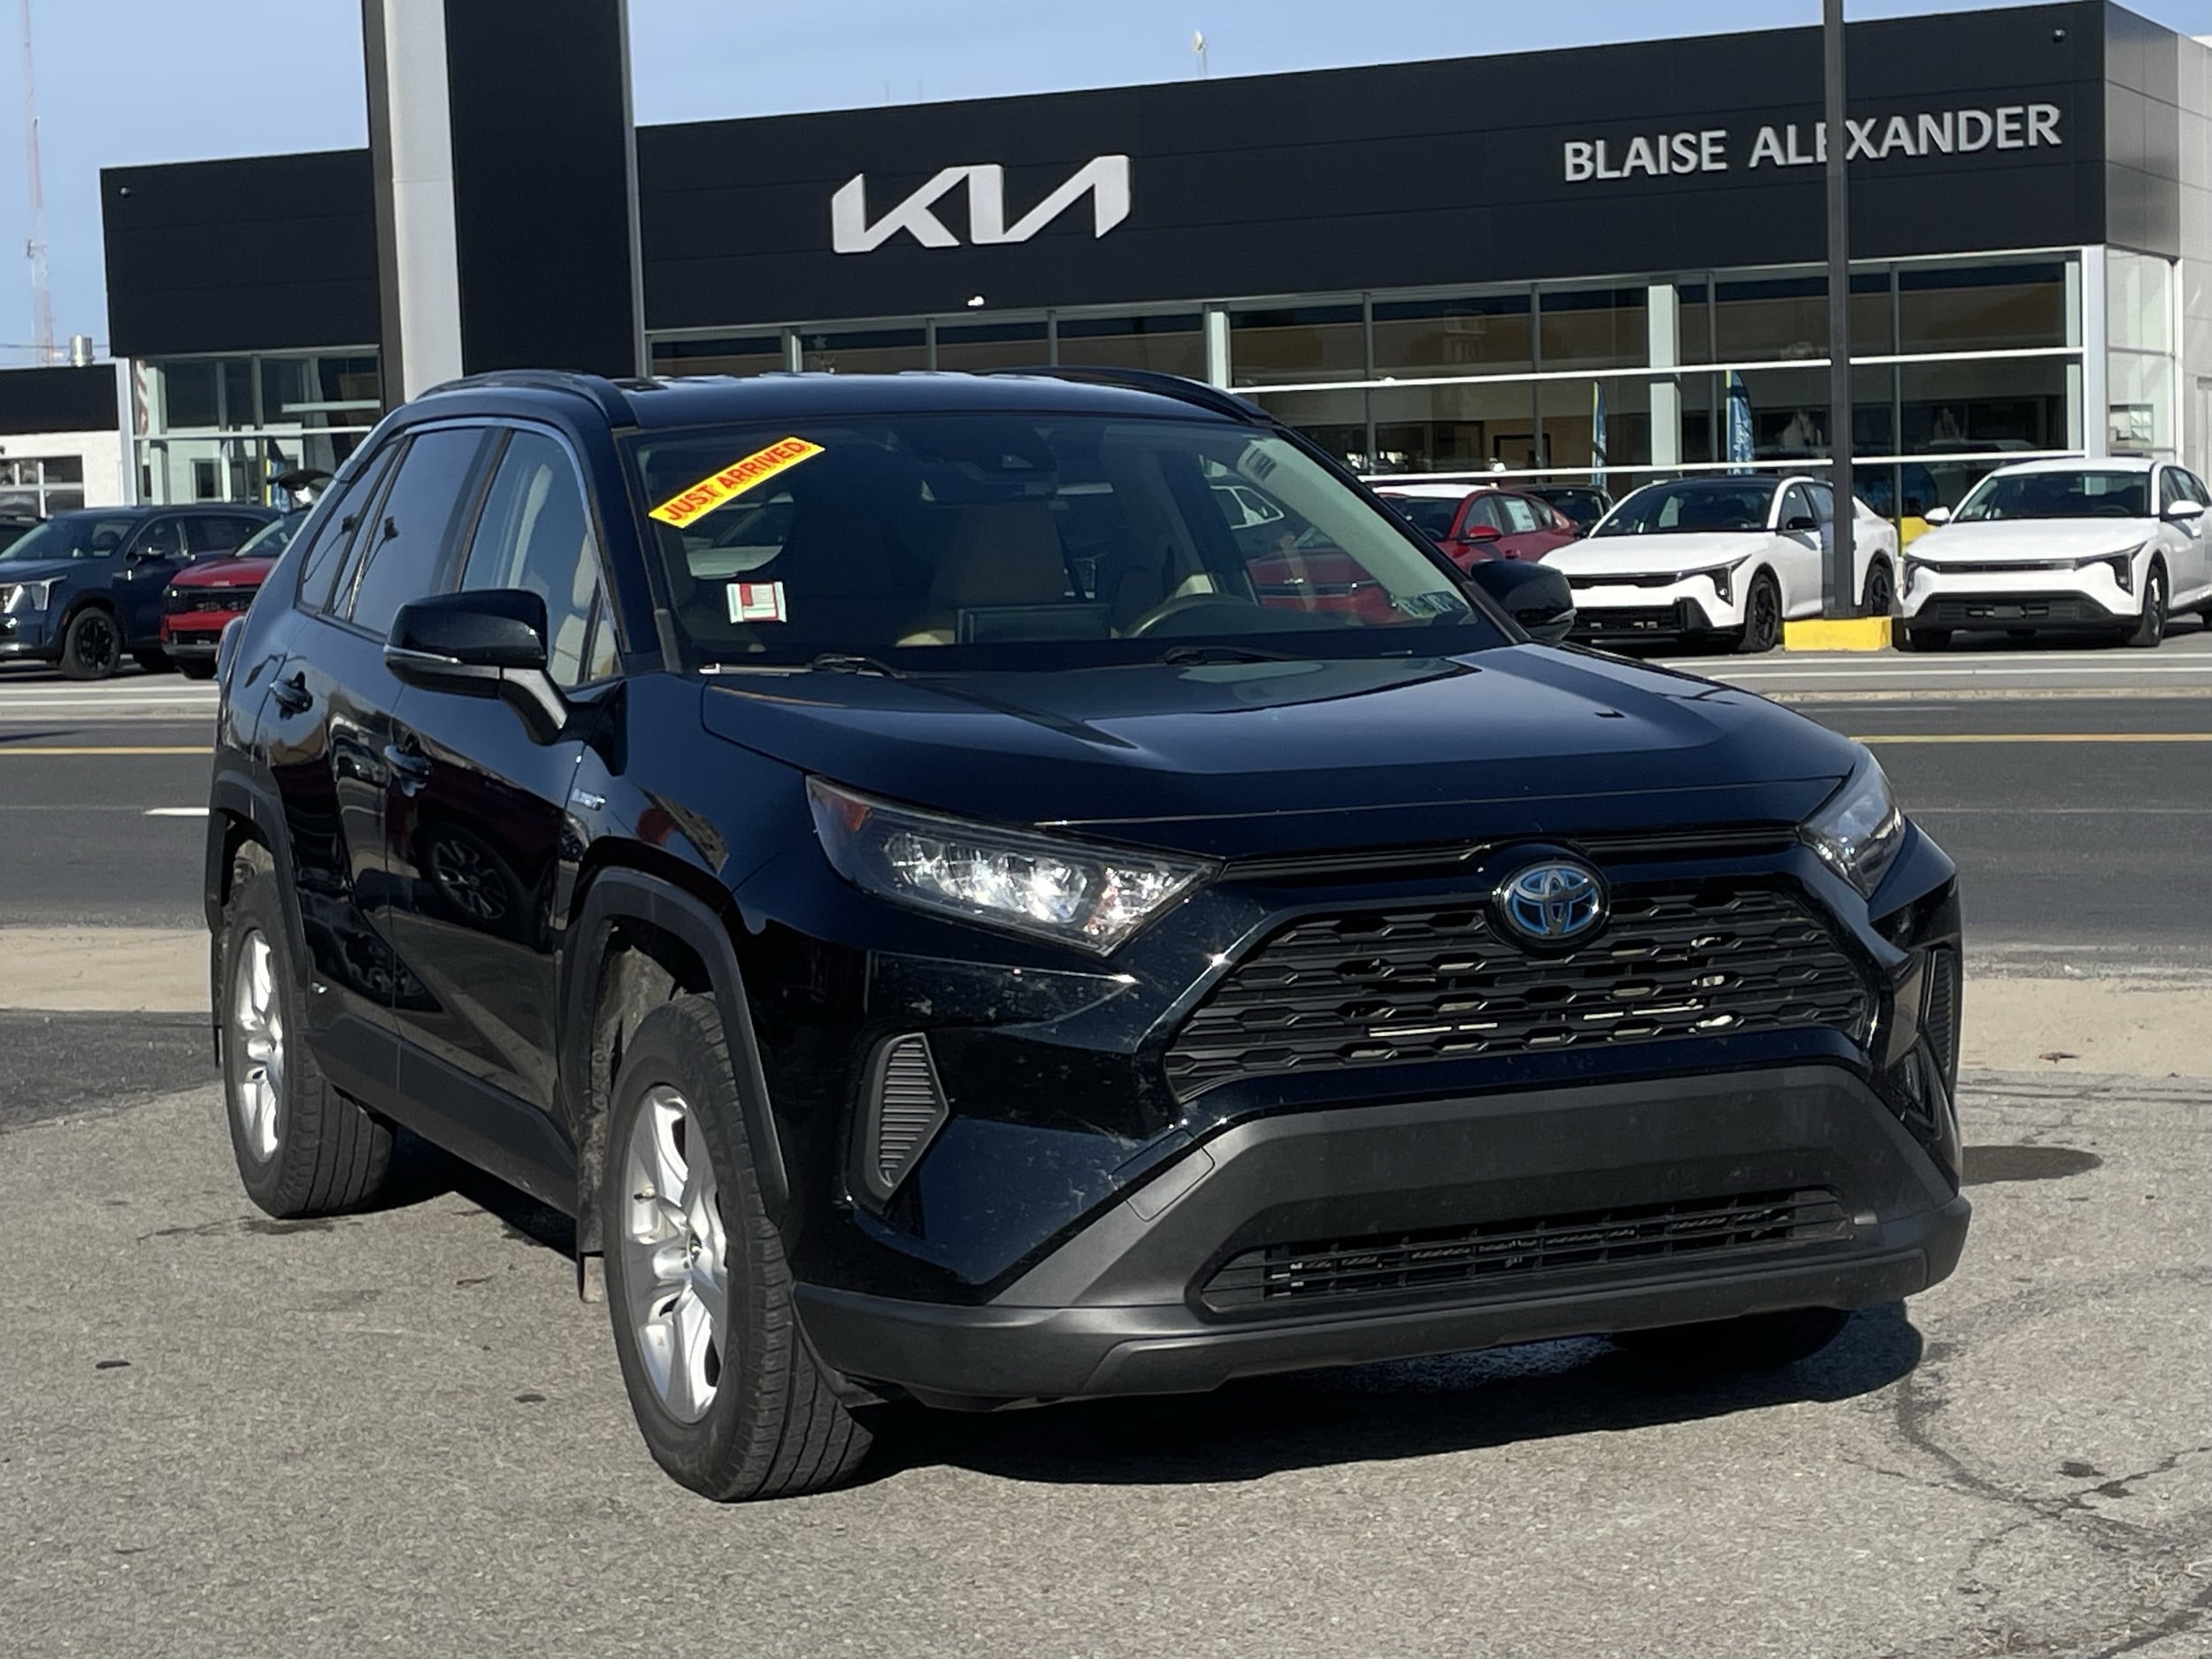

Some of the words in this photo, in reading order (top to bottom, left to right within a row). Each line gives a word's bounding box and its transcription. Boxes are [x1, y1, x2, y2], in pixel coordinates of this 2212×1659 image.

[1563, 129, 1728, 181] BLAISE
[831, 154, 1131, 254] KIA
[664, 484, 718, 520] JUST
[716, 442, 806, 488] ARRIVED
